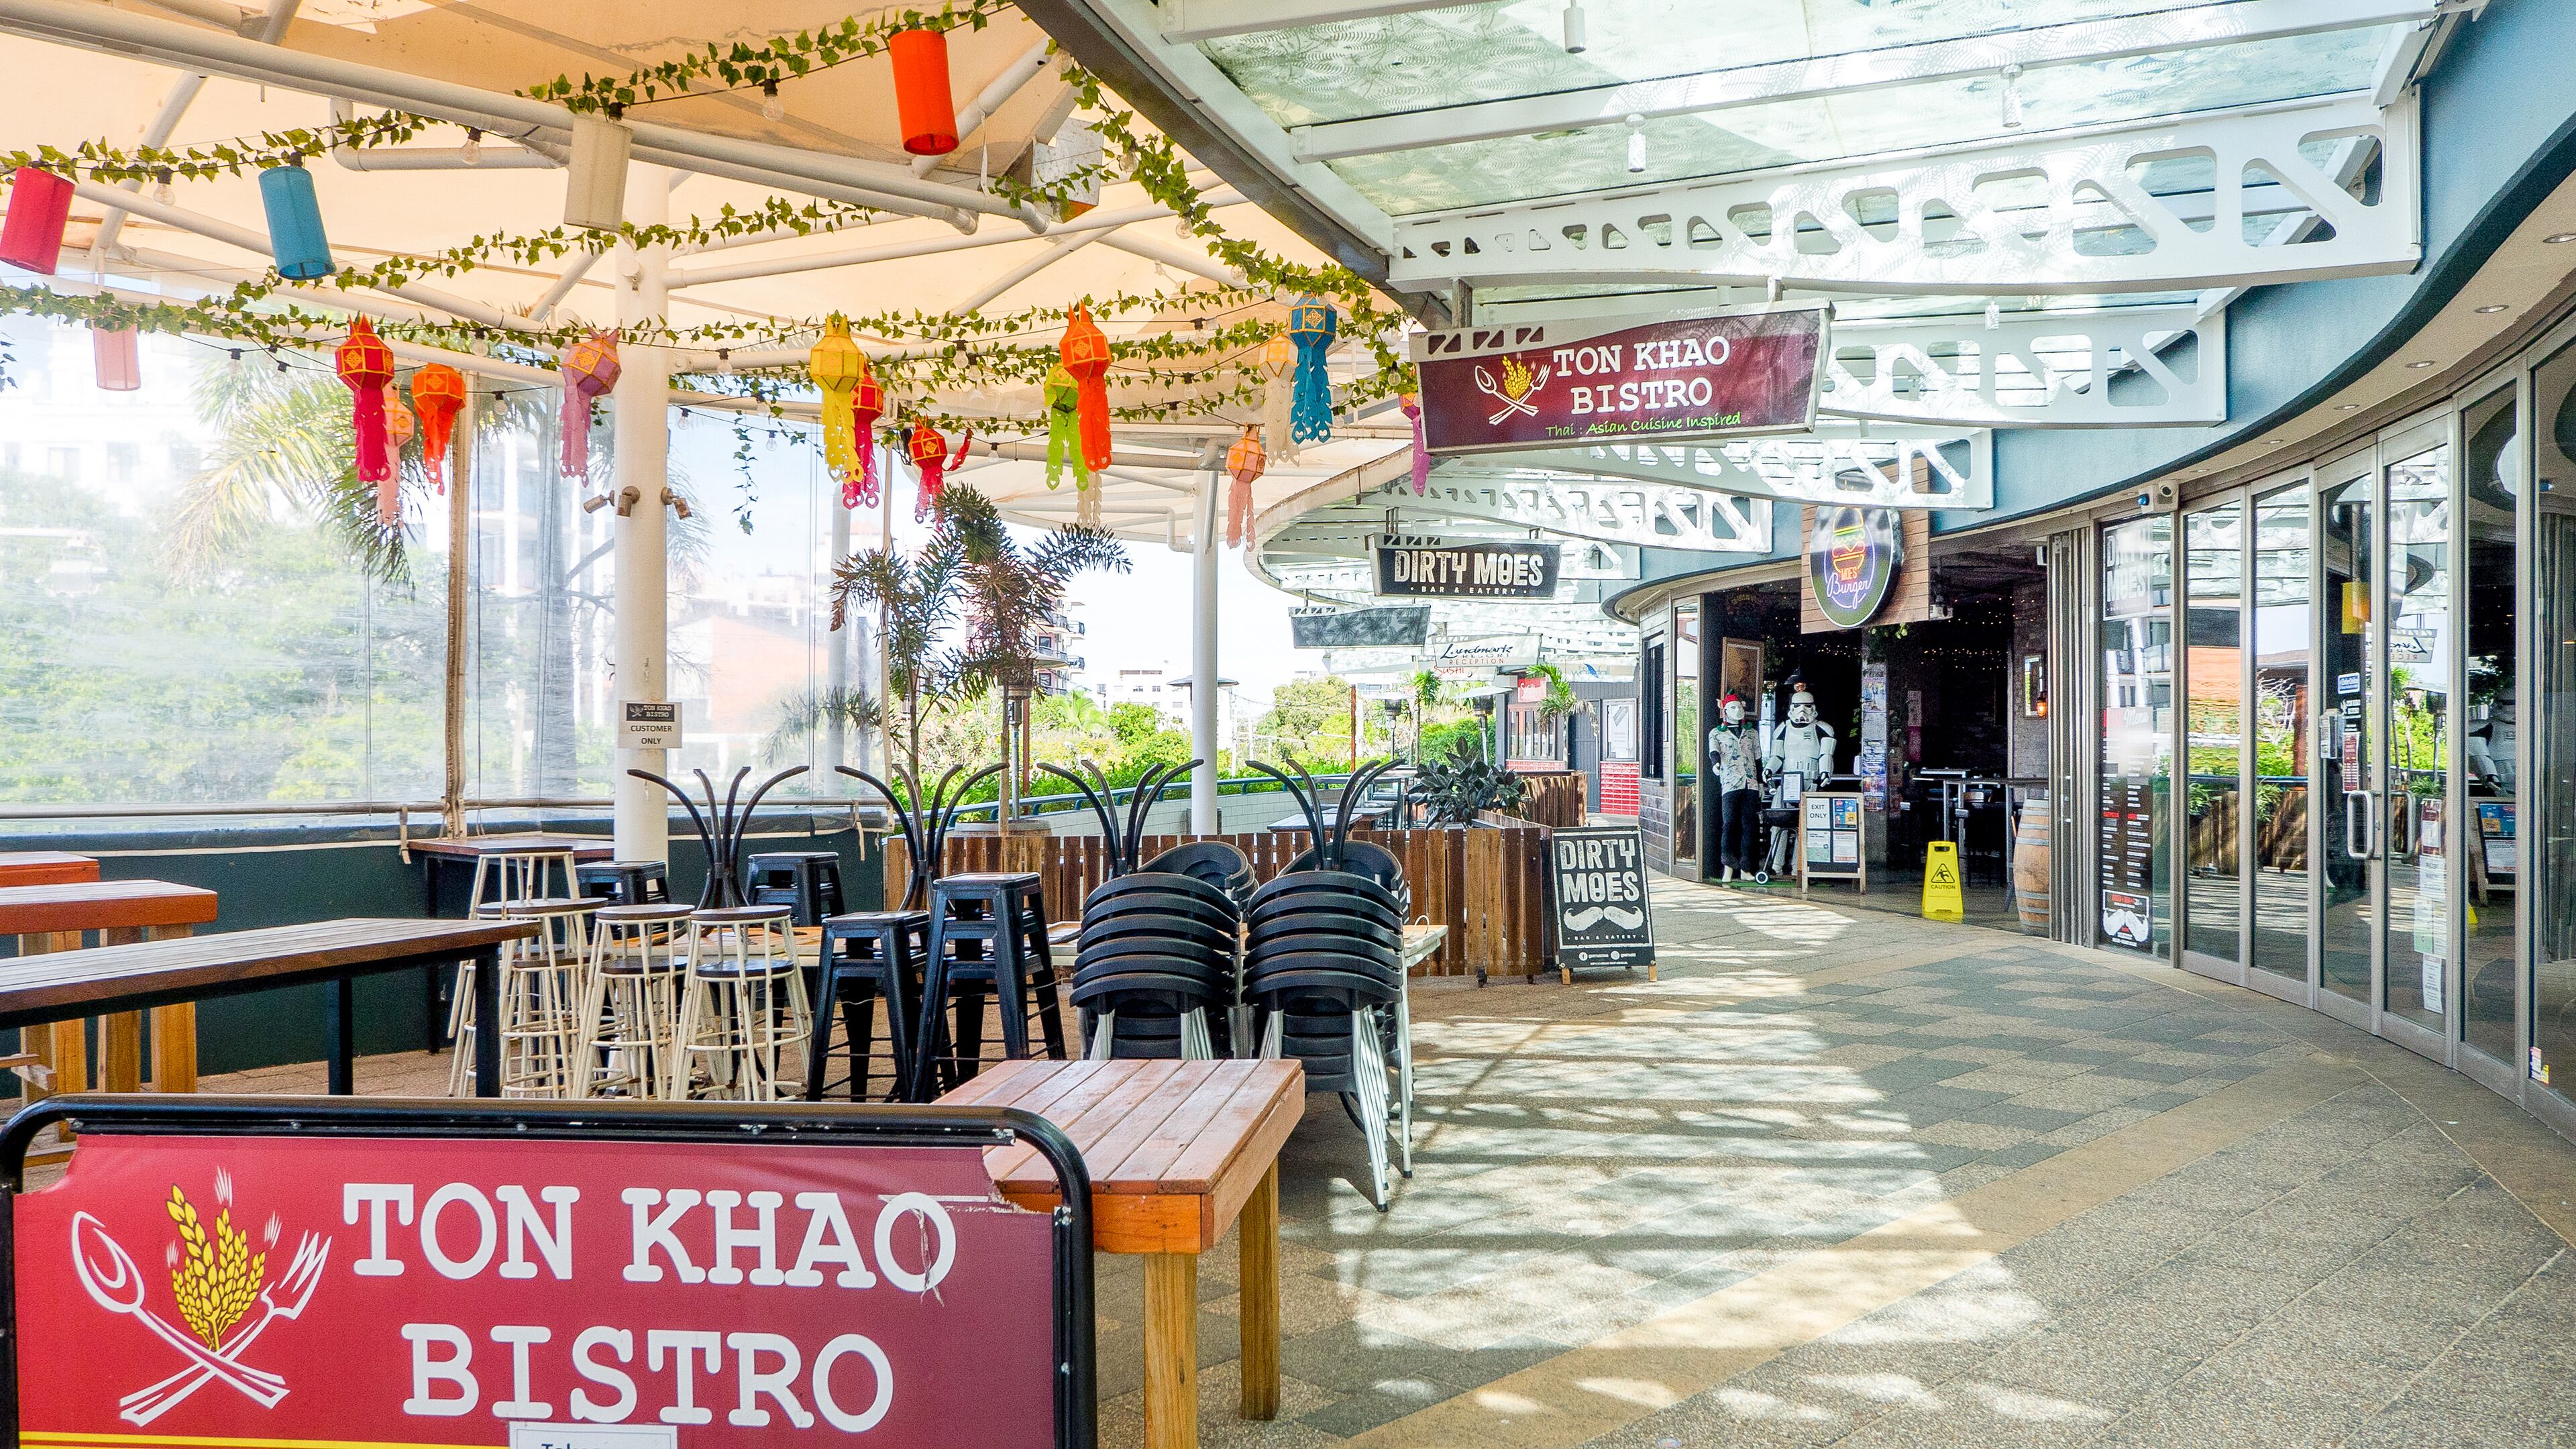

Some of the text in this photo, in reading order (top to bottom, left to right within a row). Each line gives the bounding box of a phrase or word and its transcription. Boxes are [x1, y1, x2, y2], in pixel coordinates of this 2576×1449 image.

[1553, 335, 1730, 378] TON KHAO
[1570, 377, 1713, 415] BISTRO
[1546, 423, 1576, 437] Thai
[1585, 419, 1627, 435] Asian
[1631, 417, 1682, 431] Cuisine
[1686, 411, 1741, 431] Inspired
[1394, 550, 1544, 587] DIRTY MOES
[1469, 587, 1516, 595] EATERY
[1827, 572, 1870, 610] Burger
[1440, 643, 1513, 659] Landmark
[1559, 839, 1635, 870] DIRTY
[1562, 871, 1640, 903] MOES
[343, 1182, 957, 1293] TON KHAO
[401, 1323, 894, 1433] BISTRO
